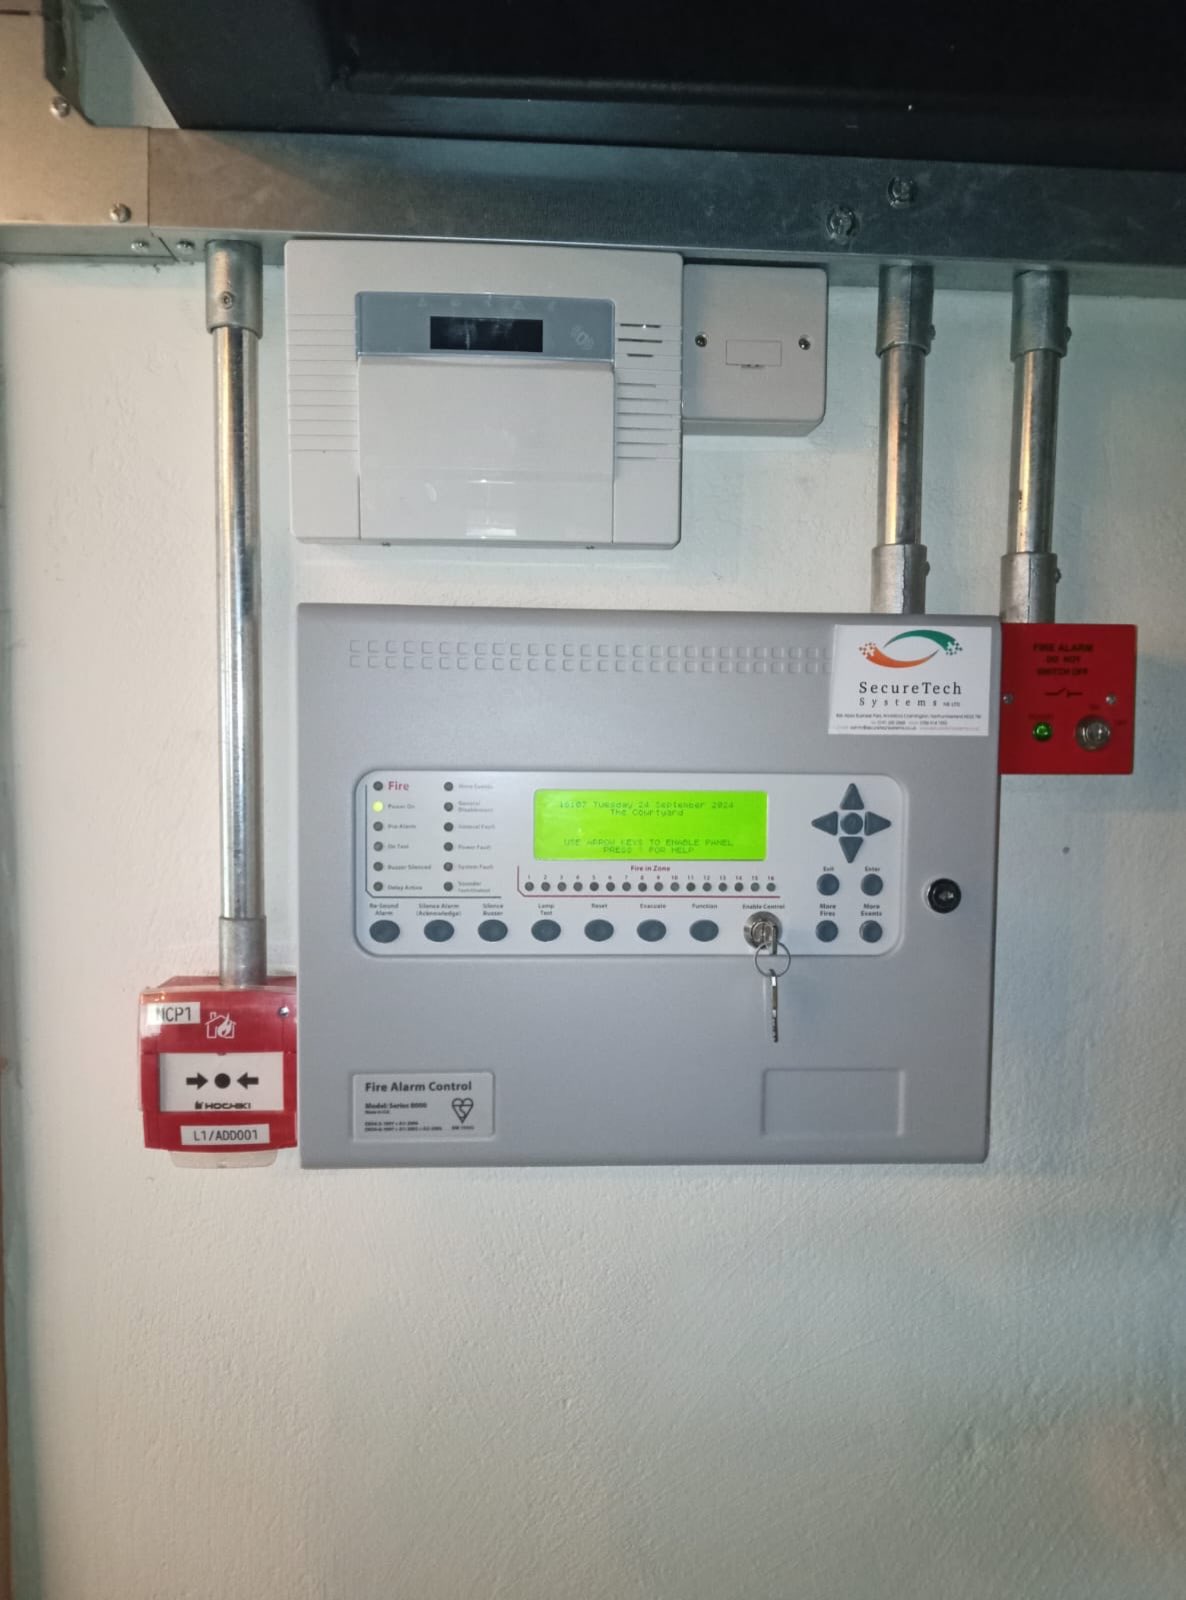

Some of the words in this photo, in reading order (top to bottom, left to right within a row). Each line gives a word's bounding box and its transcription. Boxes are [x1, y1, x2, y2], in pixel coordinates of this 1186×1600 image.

[859, 681, 962, 695] SecureTech
[859, 697, 937, 708] Systems
[388, 781, 409, 791] Fire
[593, 801, 632, 809] Tuesday
[656, 801, 704, 809] September
[632, 808, 684, 817] Courtyard
[365, 1082, 388, 1092] Fire
[390, 1081, 425, 1092] Alarm
[428, 1081, 472, 1092] Control
[194, 1130, 258, 1141] L1/ADD001
